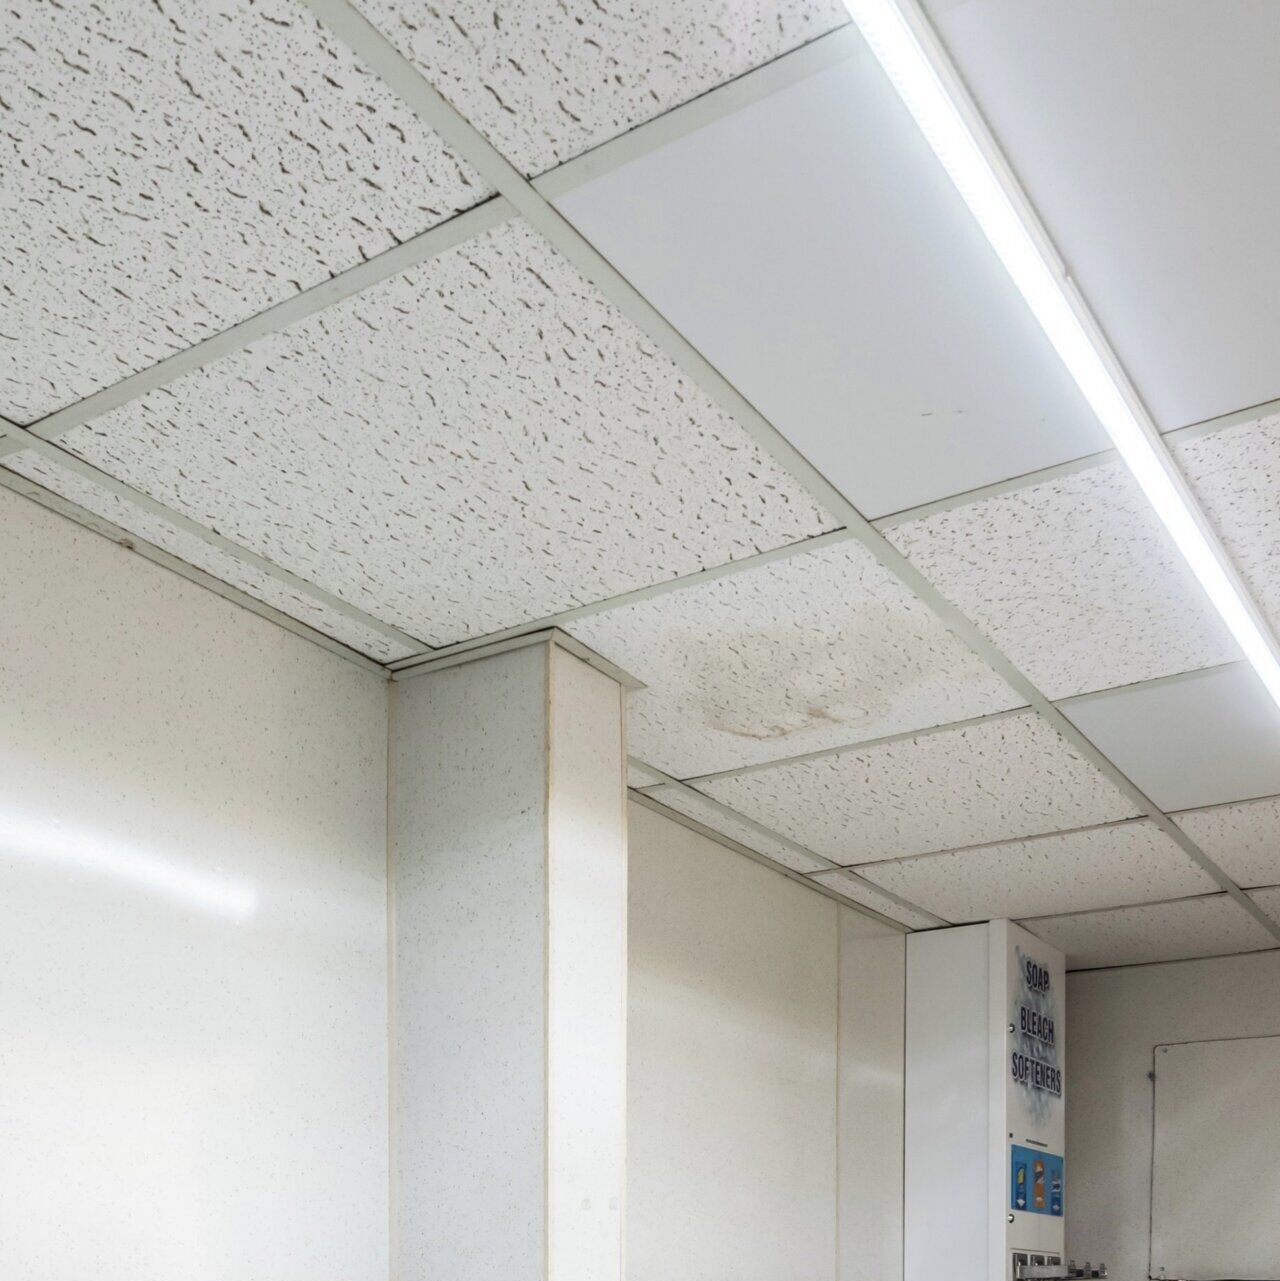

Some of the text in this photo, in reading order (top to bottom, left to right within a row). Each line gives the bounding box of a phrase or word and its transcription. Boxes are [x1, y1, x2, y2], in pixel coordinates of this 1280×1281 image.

[1026, 960, 1050, 993] SOAP
[1021, 1006, 1055, 1044] BLEACH
[1012, 1051, 1062, 1094] SOFTENERS
